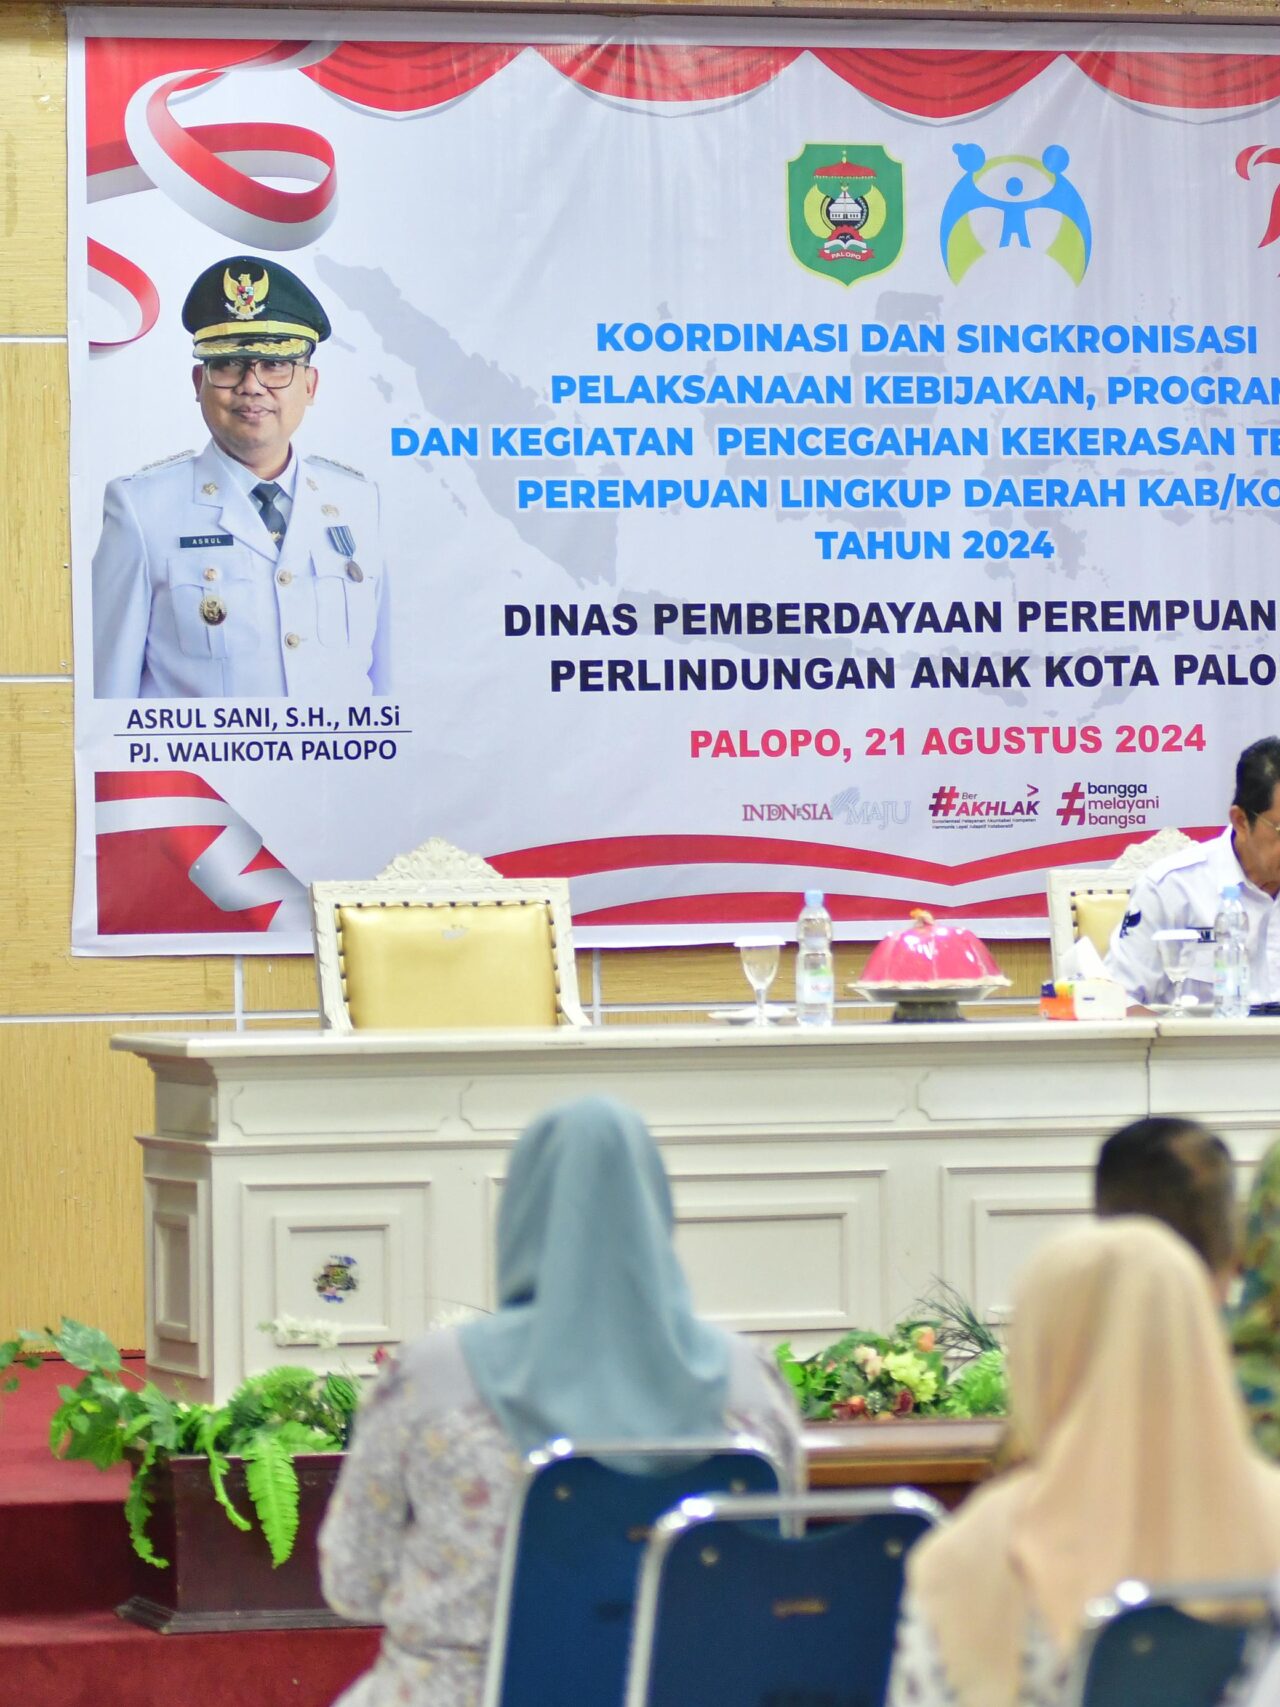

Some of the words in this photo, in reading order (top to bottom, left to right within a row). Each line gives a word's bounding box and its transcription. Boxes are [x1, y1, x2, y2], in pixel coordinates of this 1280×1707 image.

[831, 252, 861, 260] PALOPO
[596, 321, 849, 353] KOORDINASI
[861, 323, 946, 353] DAN
[956, 323, 1258, 355] SINGKRONISASI
[551, 374, 853, 405] PELAKSANAAN
[864, 375, 1097, 412] KEBIJAKAN,
[390, 426, 479, 457] DAN
[491, 426, 694, 458] KEGIATAN
[717, 426, 989, 457] PENCEGAHAN
[1001, 426, 1236, 457] KEKERASAN
[517, 479, 768, 510] PEREMPUAN
[780, 478, 952, 509] LINGKUP
[963, 478, 1126, 508] DAERAH
[192, 537, 222, 545] ASRUL
[814, 530, 951, 561] TAHUN
[962, 529, 1056, 560] 2024
[504, 603, 638, 637] DINAS
[653, 601, 1002, 636] PEMBERDAYAAN
[1018, 599, 1276, 633] PEREMPUAN
[550, 657, 895, 693] PERLINDUNGAN
[910, 655, 1032, 689] ANAK
[1045, 654, 1160, 688] KOTA
[126, 708, 207, 729] ASRUL
[213, 707, 278, 732] SANI,
[286, 707, 340, 731] S.H.,
[348, 705, 400, 727] M.Si
[130, 742, 159, 763] PJ.
[166, 740, 294, 763] WALIKOTA
[301, 739, 397, 761] PALOPO
[690, 728, 852, 763] PALOPO,
[865, 727, 906, 757] 21
[922, 725, 1103, 756] AGUSTUS
[1115, 723, 1207, 753] 2024
[961, 792, 978, 800] Ber
[1088, 795, 1160, 813] melayani
[1088, 812, 1146, 829] bangsa
